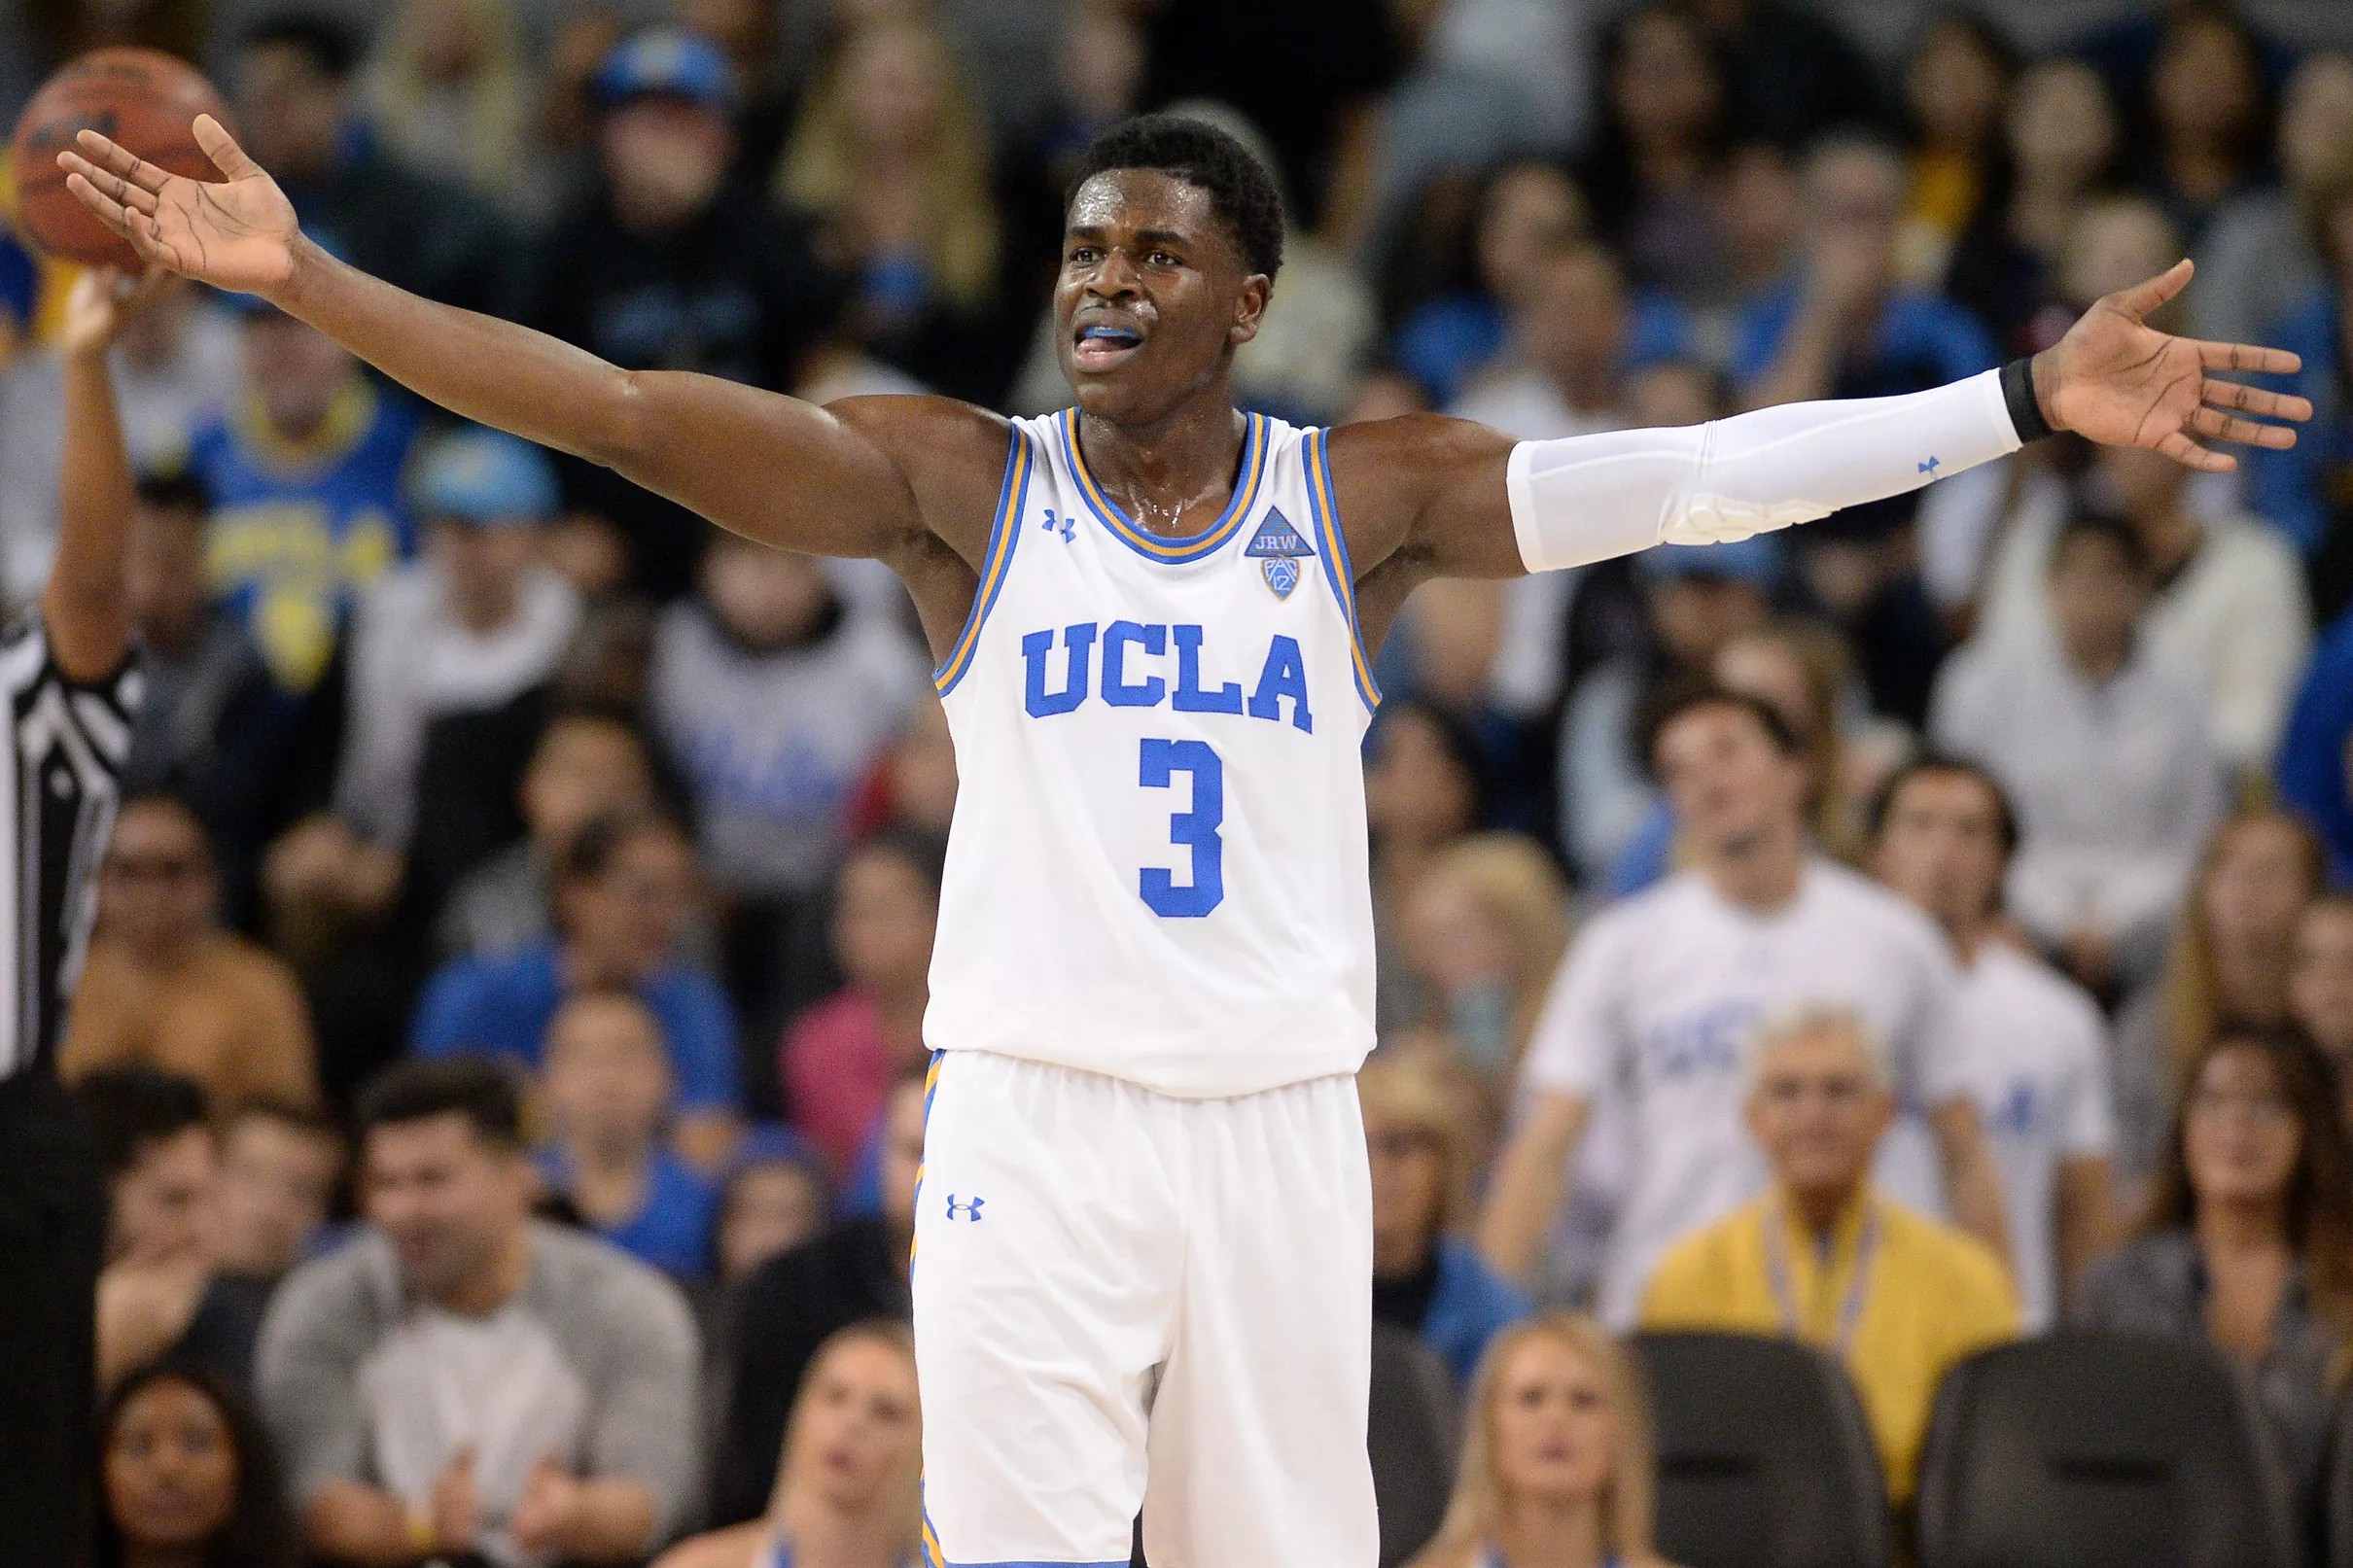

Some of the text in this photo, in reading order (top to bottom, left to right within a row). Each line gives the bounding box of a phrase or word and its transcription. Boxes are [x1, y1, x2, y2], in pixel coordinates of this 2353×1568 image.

[1255, 535, 1298, 550] JRW
[1265, 559, 1298, 583] PAC
[1273, 575, 1290, 591] 12
[1022, 620, 1313, 735] UCLA
[1139, 738, 1224, 918] 3
